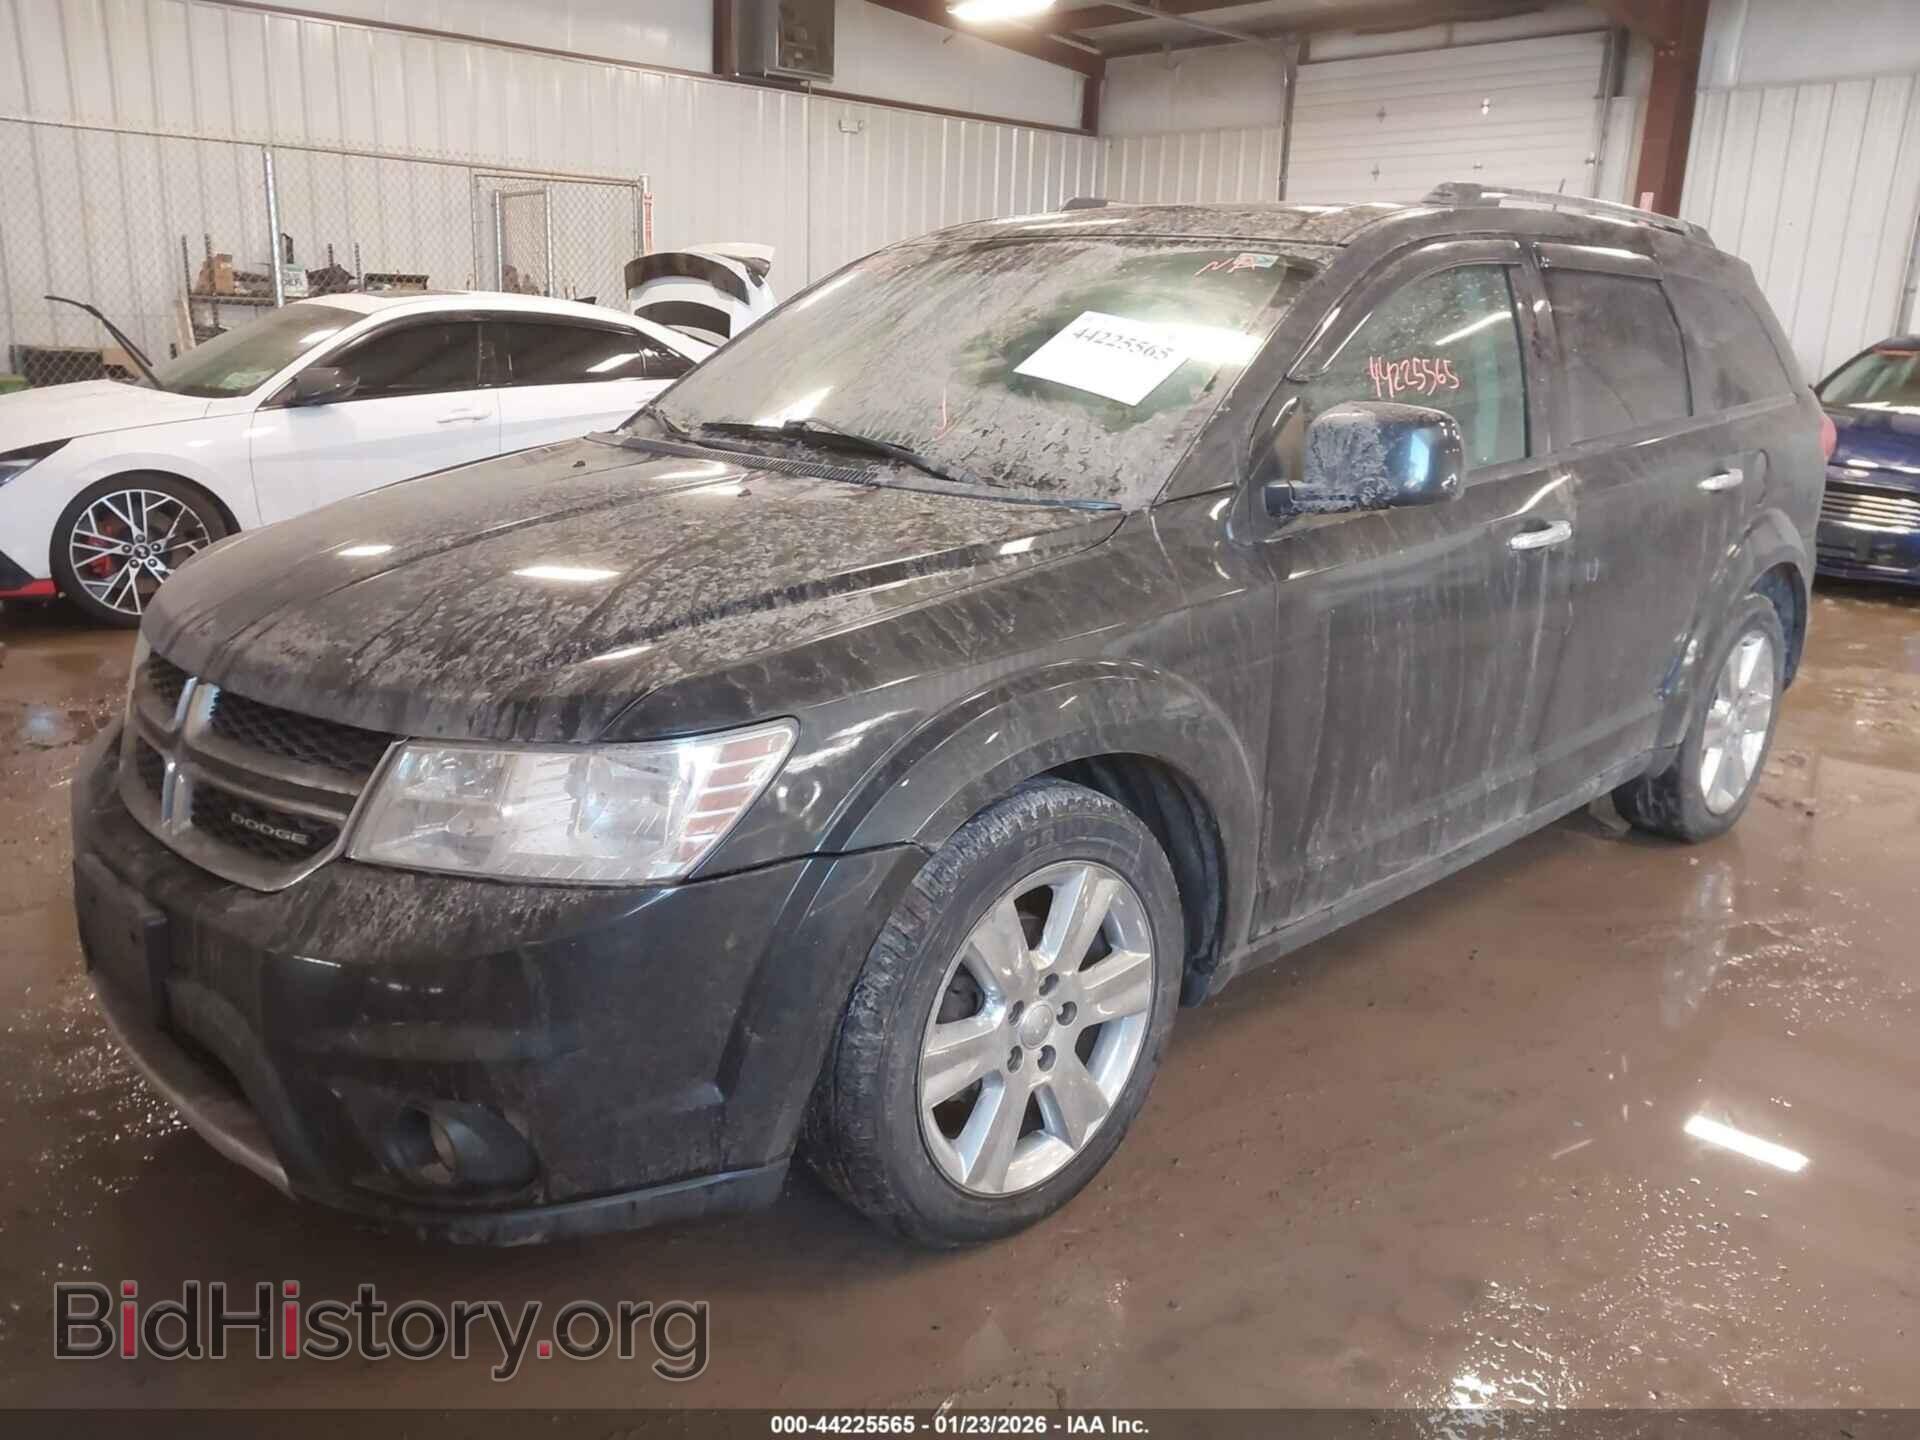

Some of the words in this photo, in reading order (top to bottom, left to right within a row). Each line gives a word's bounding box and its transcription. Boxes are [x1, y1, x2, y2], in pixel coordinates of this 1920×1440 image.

[1072, 327, 1175, 361] 44225565
[1369, 355, 1460, 398] 44225565
[231, 812, 308, 846] DODGE
